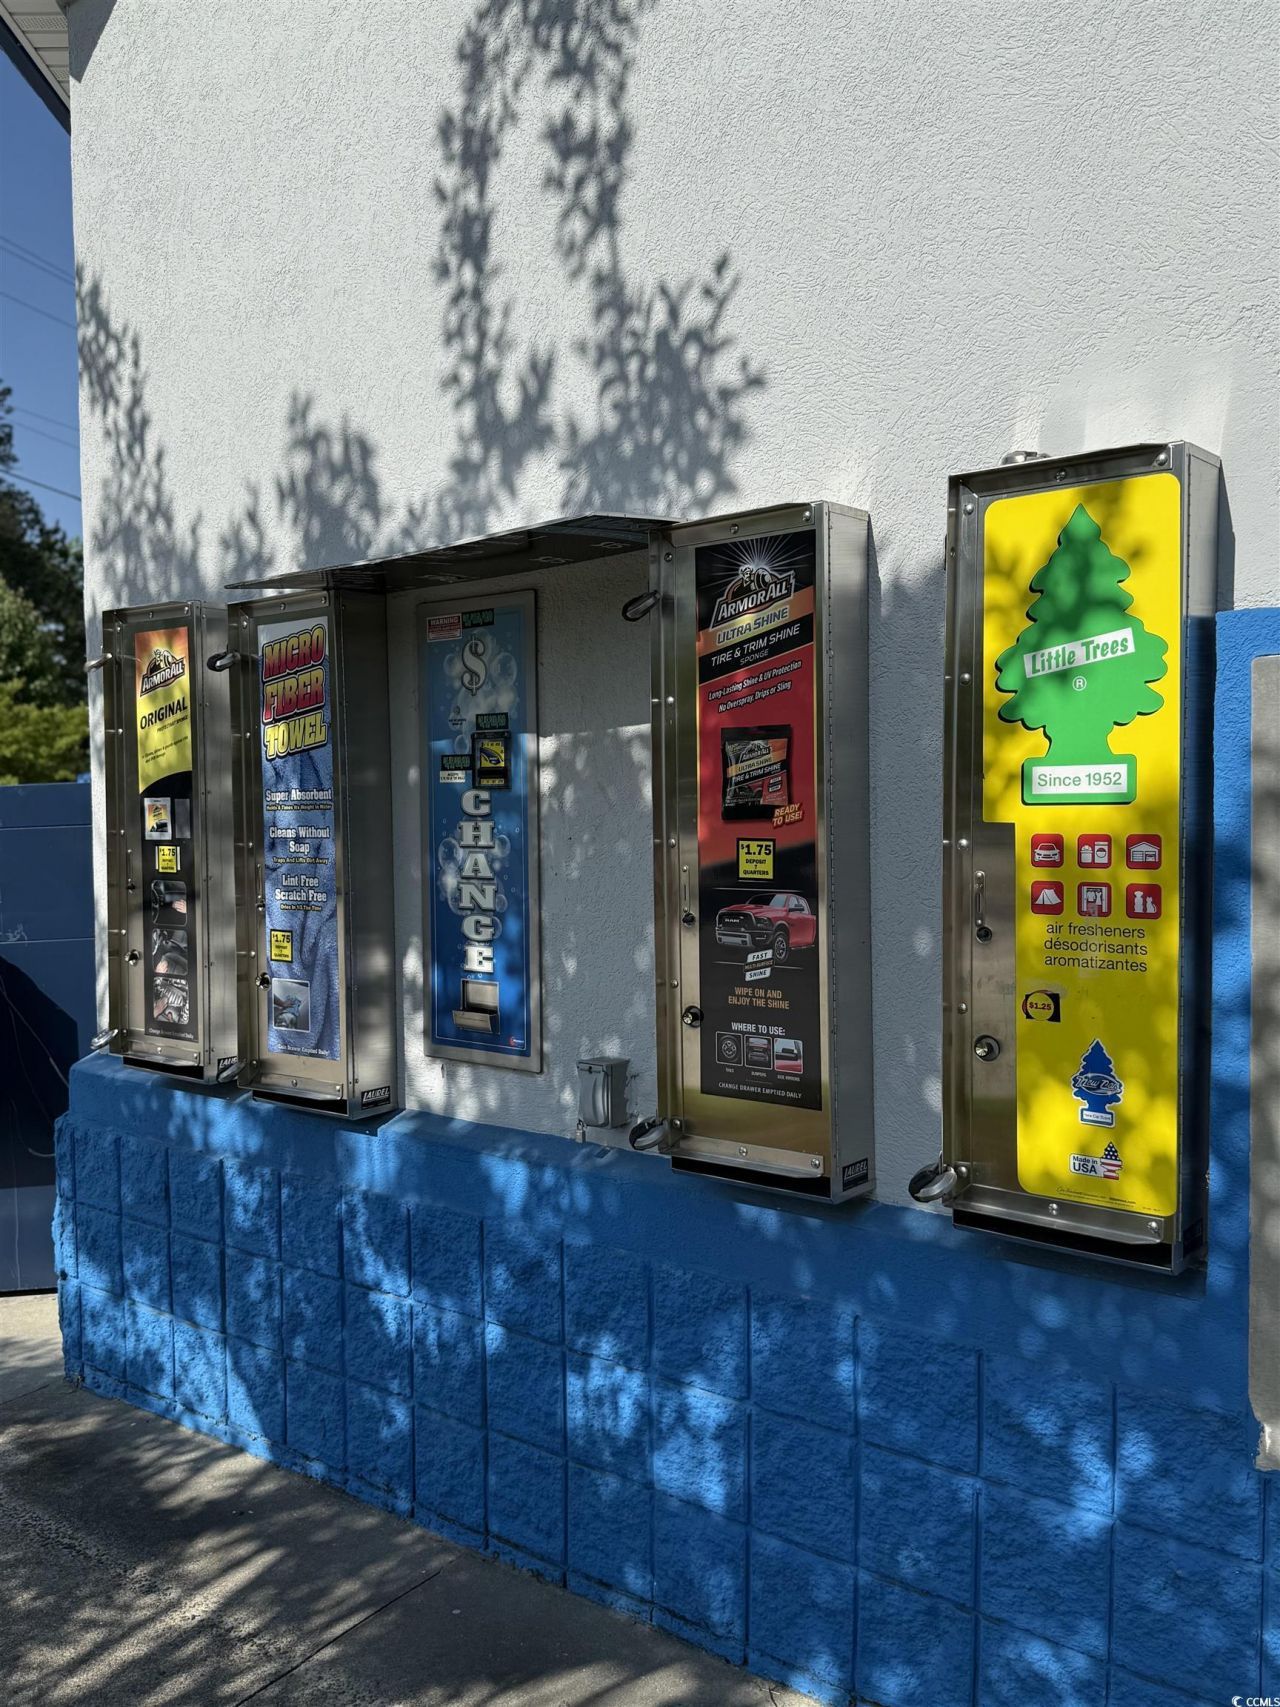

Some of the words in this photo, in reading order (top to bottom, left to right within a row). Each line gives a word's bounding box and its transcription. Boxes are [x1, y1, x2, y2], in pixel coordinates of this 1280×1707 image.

[717, 624, 752, 645] ULTRA
[753, 606, 790, 631] SHINE
[711, 653, 733, 667] TIRE
[733, 648, 742, 659] &
[743, 637, 768, 654] TRIM
[769, 623, 801, 645] SHINE
[263, 625, 325, 681] MICRO
[740, 649, 769, 666] SPONGE
[1031, 648, 1076, 675] Little
[1081, 637, 1129, 664] Trees
[708, 679, 743, 701] Long-Lasting
[742, 673, 758, 689] Shine
[763, 669, 772, 681] UV
[772, 660, 802, 676] Protection
[263, 667, 325, 721] FIBER
[718, 702, 727, 713] No
[754, 687, 770, 701] Drips
[777, 680, 792, 694] Sling
[140, 697, 188, 730] ORIGINAL
[265, 711, 327, 759] TOWEL
[1037, 773, 1082, 788] Since
[1085, 771, 1123, 786] 1952
[266, 790, 289, 803] Super
[291, 788, 332, 800] Absorbent
[774, 804, 800, 818] READY
[773, 817, 783, 827] TO
[785, 811, 803, 824] USE!
[269, 826, 297, 838] Cleans
[298, 826, 330, 838] Without
[289, 841, 310, 854] Soap
[741, 843, 772, 856] $1.75
[282, 875, 298, 886] Lint
[300, 875, 319, 887] Free
[275, 889, 307, 901] Scratch
[308, 890, 327, 902] Free
[1046, 922, 1064, 934] air
[1068, 923, 1146, 938] fresheners
[1044, 937, 1148, 956] désodorisants
[752, 952, 768, 960] FAST
[1044, 954, 1148, 972] aromatizantes
[734, 986, 753, 997] WIPE
[754, 988, 766, 998] ON
[766, 989, 782, 999] AND
[728, 995, 751, 1006] ENJOY
[751, 997, 766, 1008] THE
[767, 999, 790, 1010] SHINE
[1028, 1000, 1052, 1012] $1.25
[731, 1021, 757, 1033] WHERE
[757, 1024, 767, 1034] TO
[769, 1026, 786, 1036] USE:
[1076, 1075, 1100, 1090] New
[362, 1087, 390, 1102] LAUREL
[718, 1082, 739, 1090] CHANGE
[739, 1084, 761, 1093] DRAWER
[762, 1087, 785, 1096] EMPTIED
[786, 1091, 802, 1099] DAILY
[1073, 1156, 1091, 1164] Made
[1073, 1162, 1098, 1175] USA
